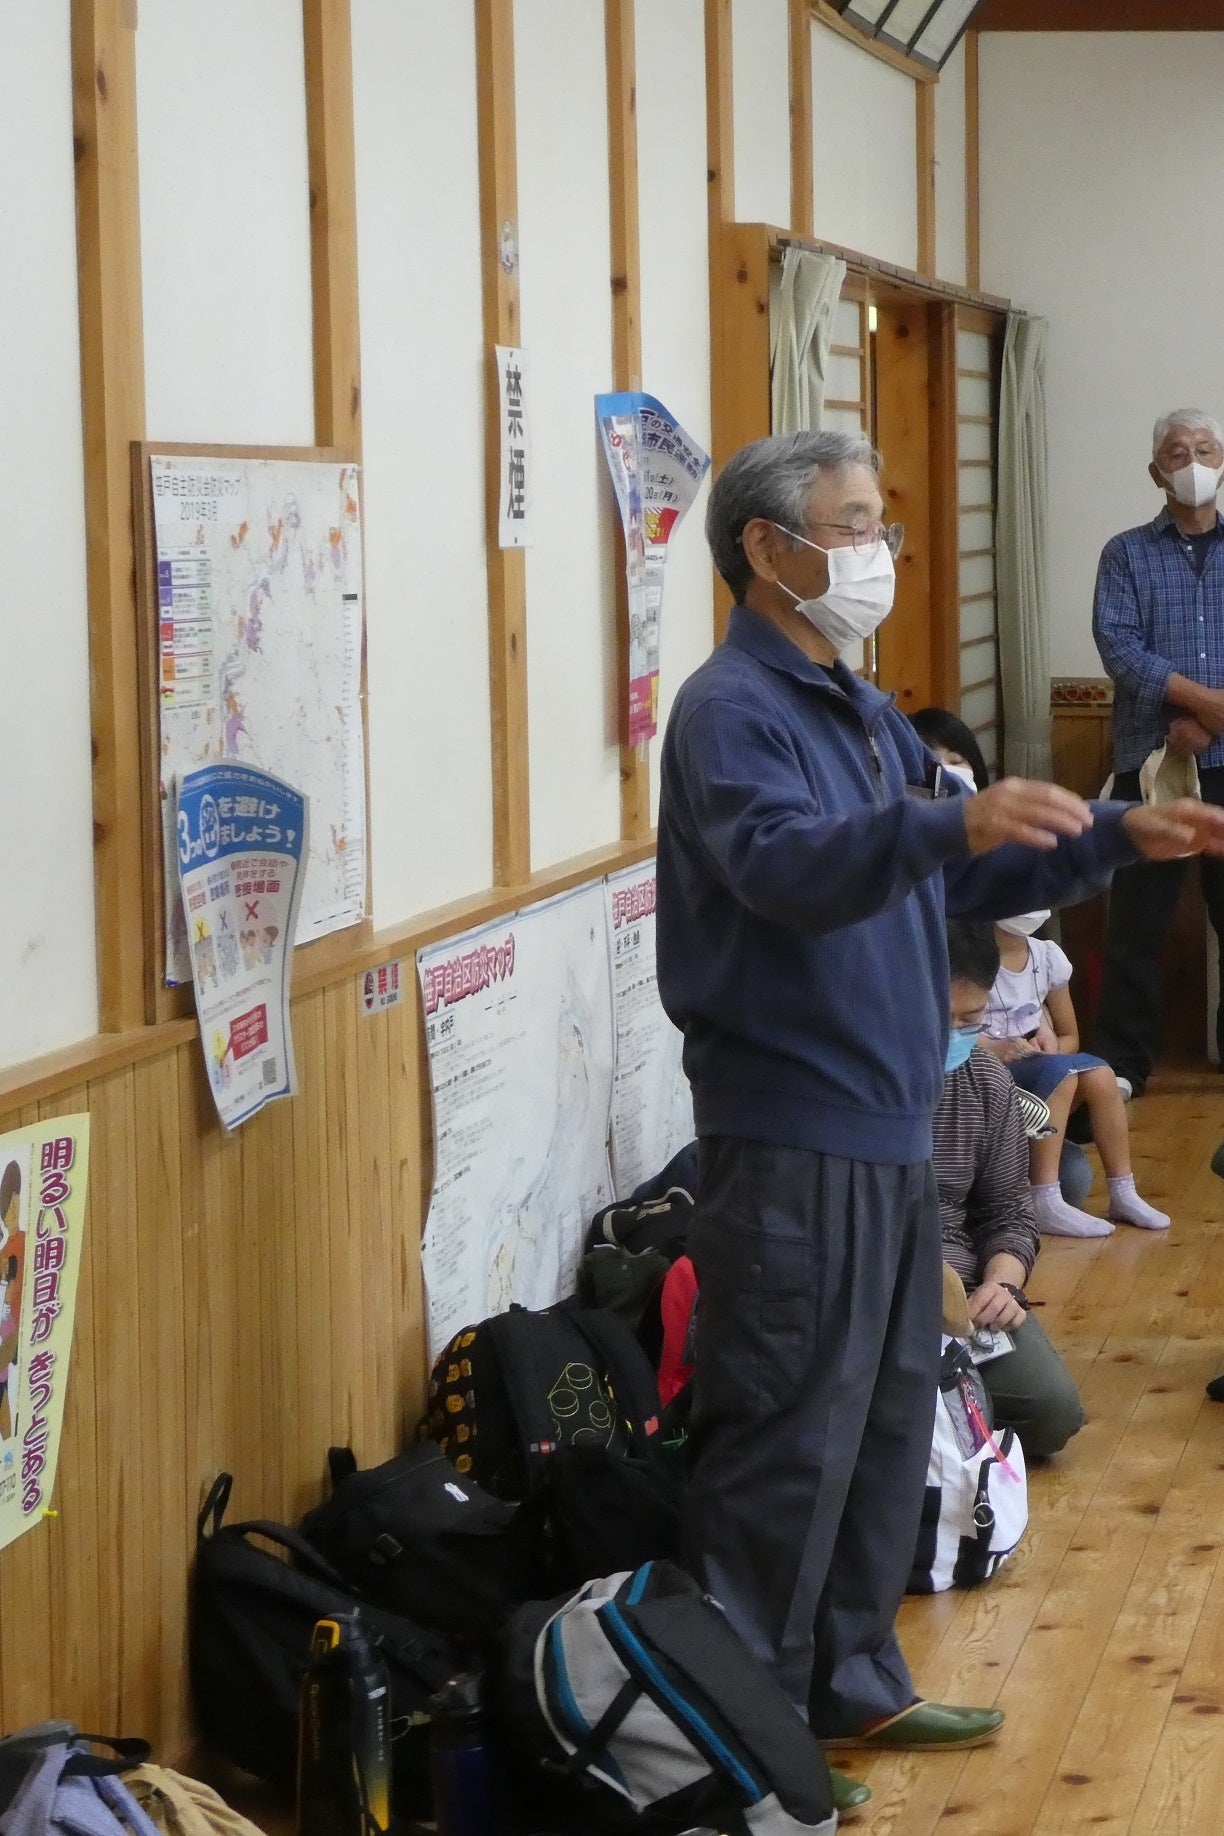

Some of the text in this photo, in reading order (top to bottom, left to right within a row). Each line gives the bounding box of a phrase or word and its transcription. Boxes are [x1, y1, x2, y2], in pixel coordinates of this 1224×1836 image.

[506, 364, 525, 519] 禁煙
[218, 796, 280, 818] を避け
[220, 823, 295, 848] ましょう!
[22, 1136, 73, 1514] 明るい明日が きっとある
